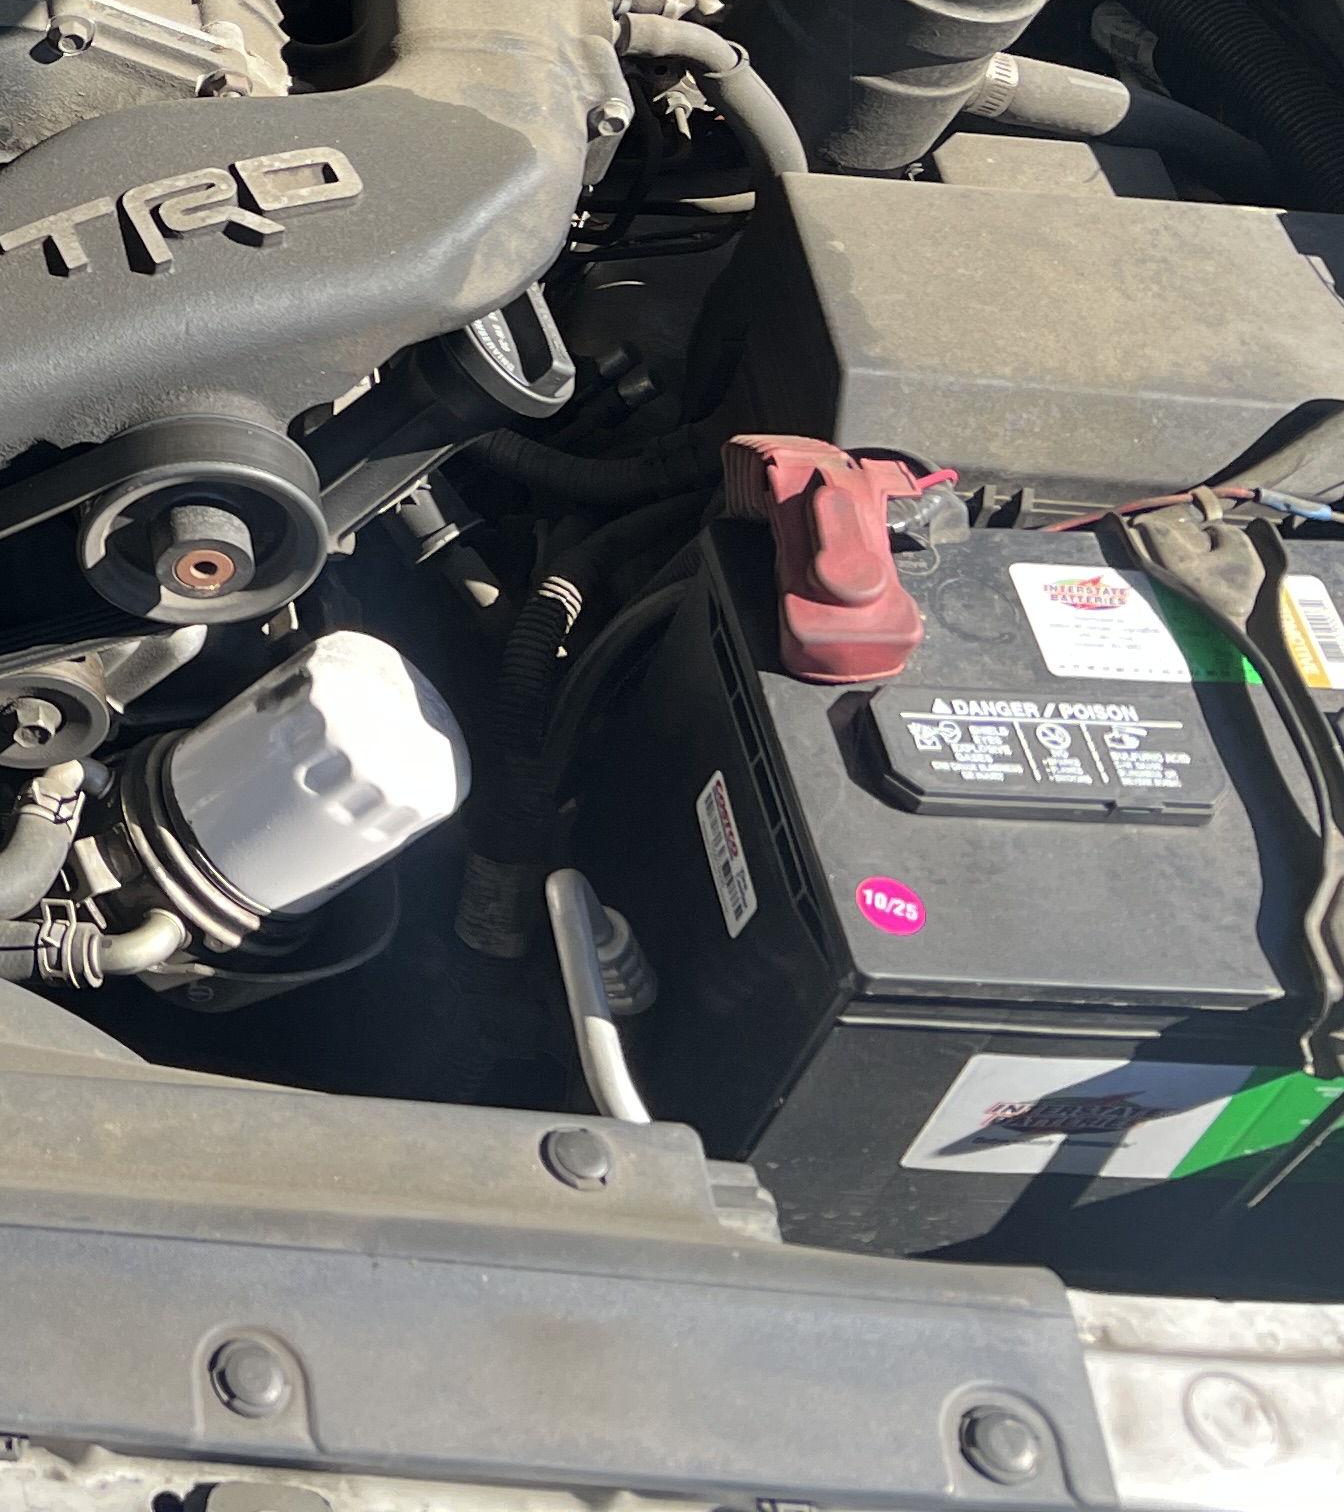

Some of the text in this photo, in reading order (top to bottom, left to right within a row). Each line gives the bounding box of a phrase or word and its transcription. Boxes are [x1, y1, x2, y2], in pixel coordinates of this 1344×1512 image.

[1043, 583, 1127, 596] INTERSTATE
[1050, 593, 1126, 606] BATTERIES
[952, 699, 1040, 718] DANGER
[1058, 702, 1140, 721] POISON
[861, 888, 919, 922] 10/25
